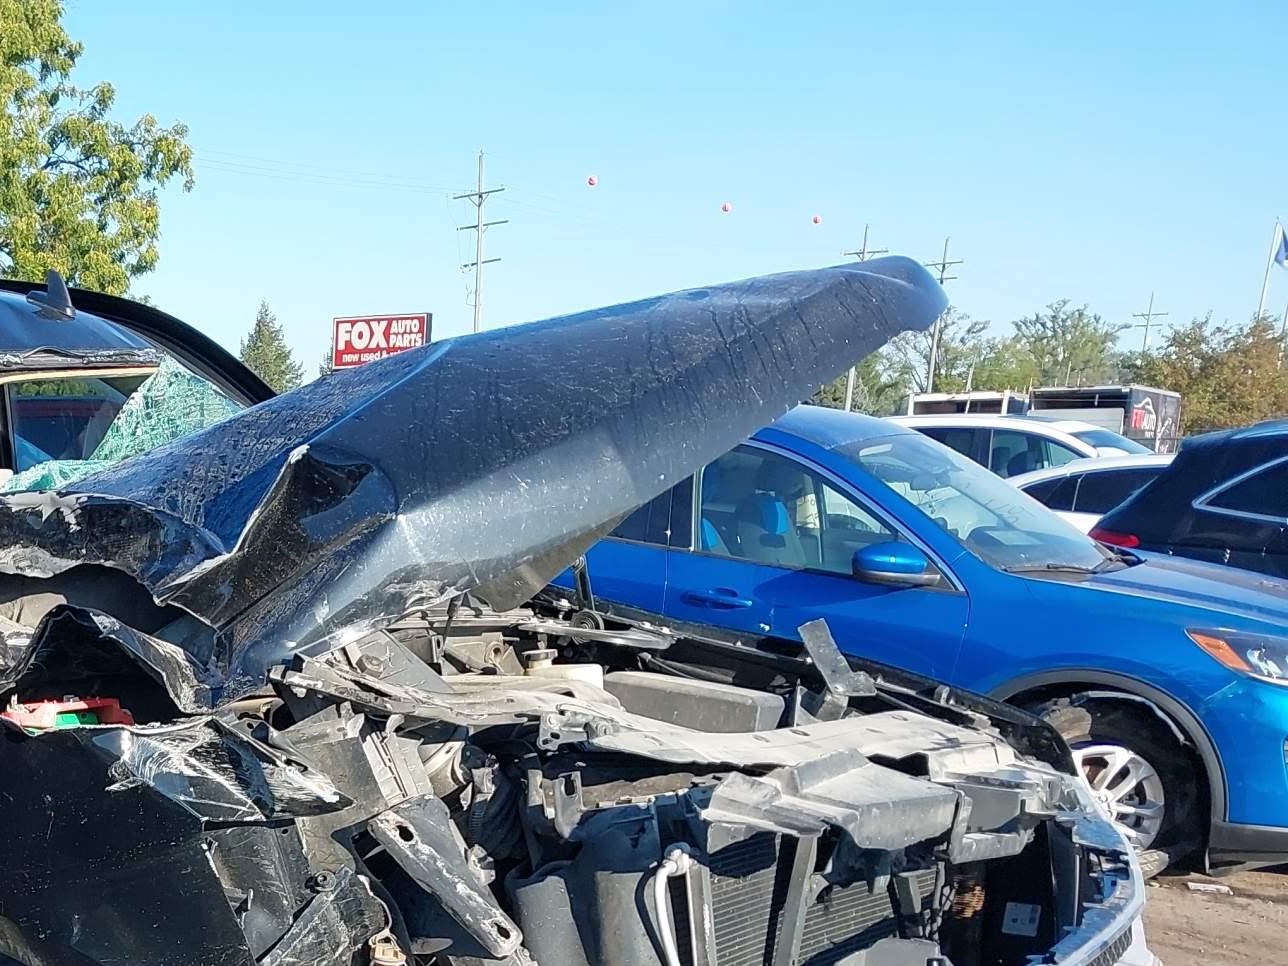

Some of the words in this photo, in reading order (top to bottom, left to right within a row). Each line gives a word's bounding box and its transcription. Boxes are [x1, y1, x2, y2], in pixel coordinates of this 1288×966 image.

[390, 319, 419, 333] AUTO
[337, 320, 388, 350] FOX
[389, 333, 422, 348] PARTS
[343, 353, 359, 362] new
[361, 351, 381, 361] used
